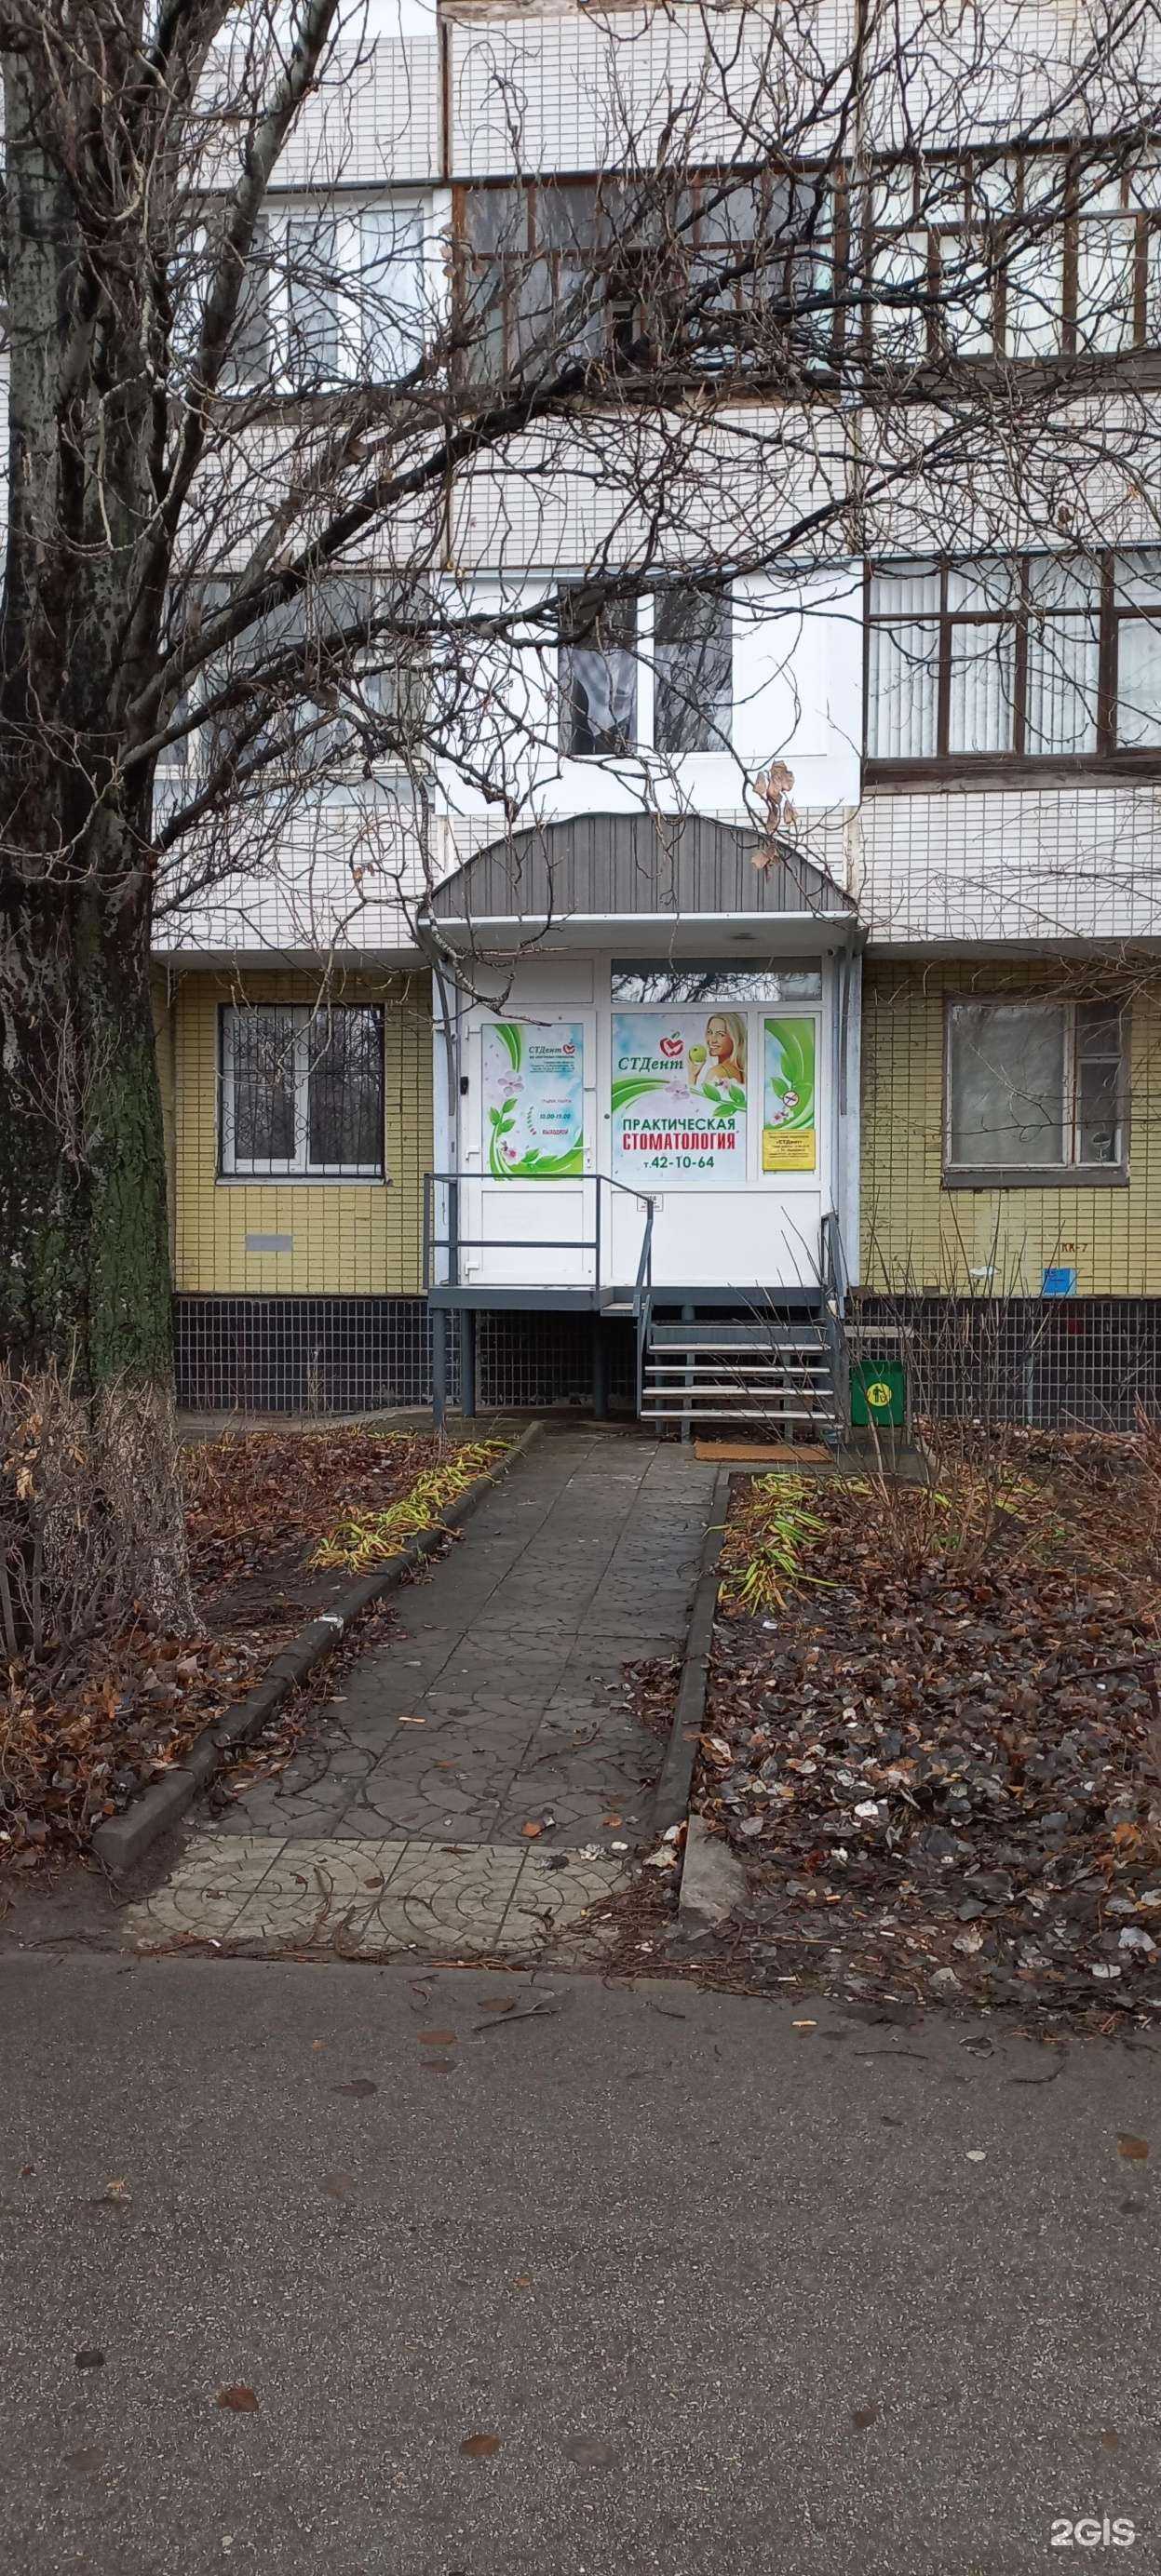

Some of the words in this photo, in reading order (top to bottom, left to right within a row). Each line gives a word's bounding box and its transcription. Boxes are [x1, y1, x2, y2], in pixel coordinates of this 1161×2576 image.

[528, 1046, 562, 1054] СТДент
[618, 1057, 684, 1072] СТДент
[623, 1119, 736, 1131] ПРАКТИЧЕСКАЯ
[623, 1133, 736, 1150] СТОМАТОЛОГИЯ
